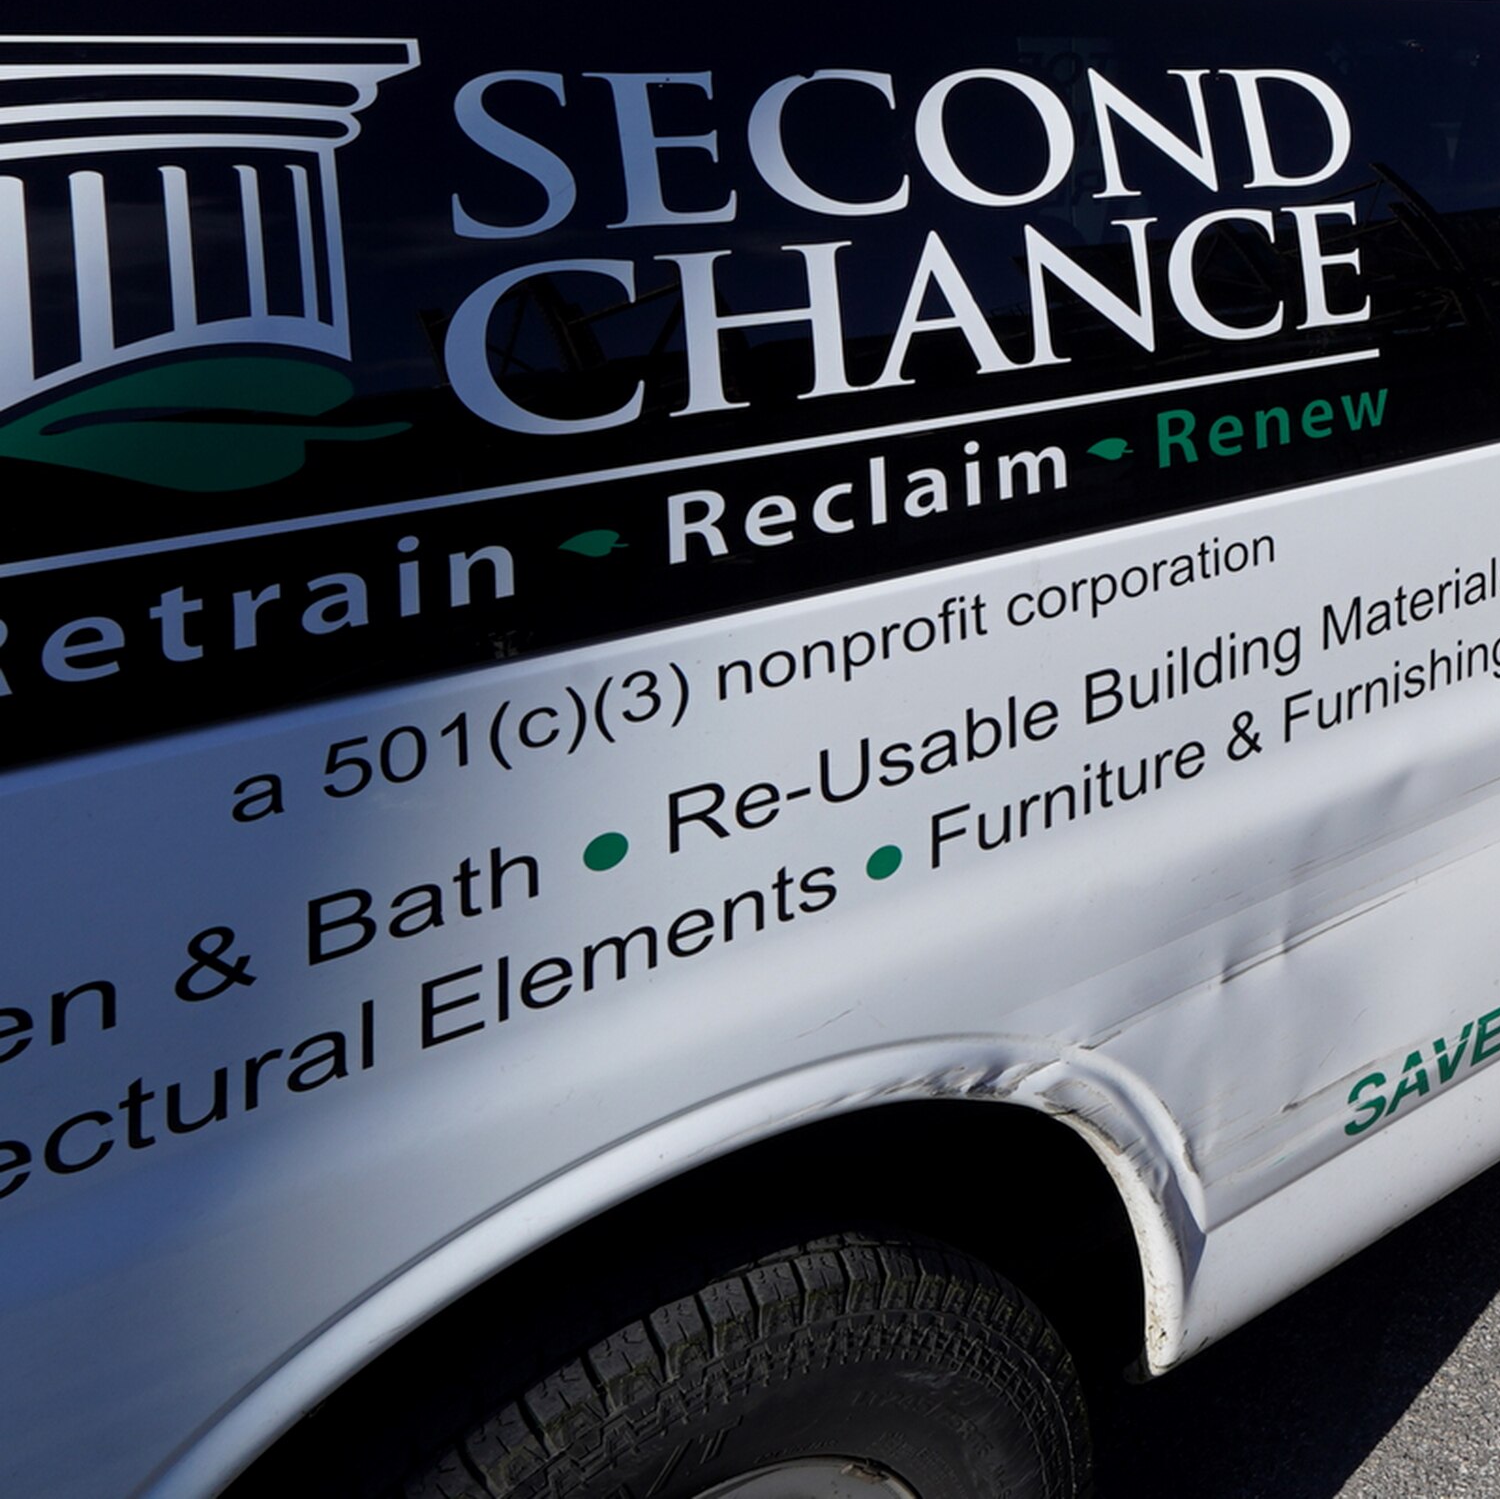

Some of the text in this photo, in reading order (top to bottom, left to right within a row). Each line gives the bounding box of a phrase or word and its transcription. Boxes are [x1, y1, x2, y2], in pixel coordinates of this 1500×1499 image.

[450, 67, 1352, 240] SECOND
[443, 201, 1373, 436] CHANCE
[0, 386, 1390, 697] etrain Reclaim Renew
[232, 535, 1275, 823] a 501(c)(3) nonprofit corporation
[174, 926, 257, 1002] &
[307, 846, 540, 966] Bath
[668, 695, 1060, 855] Re-Usable
[1084, 625, 1301, 726] Building
[421, 864, 838, 1050] Elements
[931, 740, 1206, 870] Furniture
[1226, 710, 1263, 762] &
